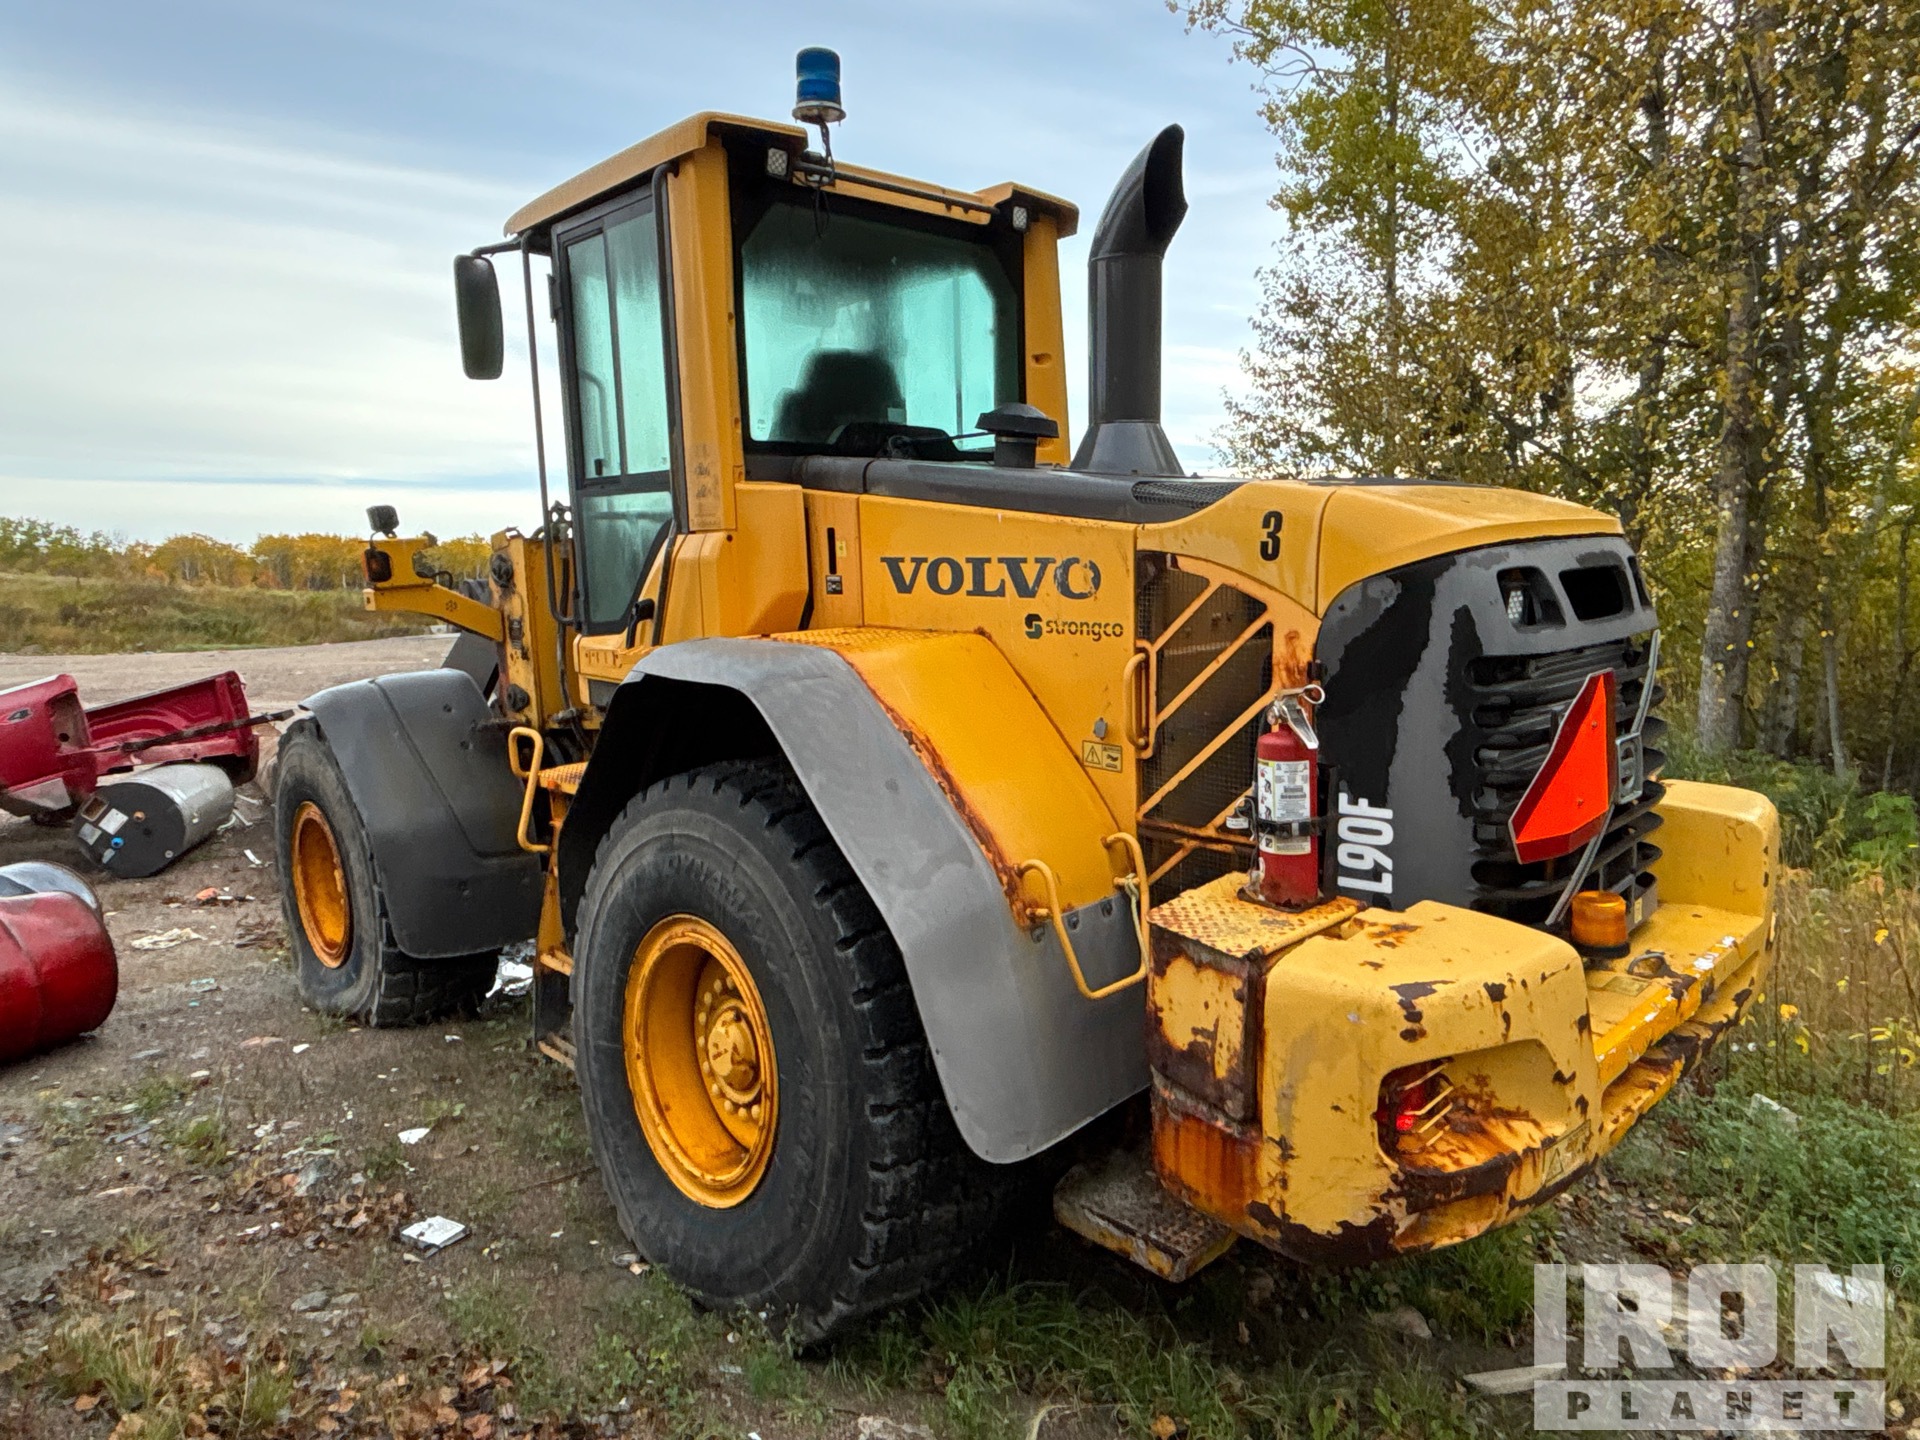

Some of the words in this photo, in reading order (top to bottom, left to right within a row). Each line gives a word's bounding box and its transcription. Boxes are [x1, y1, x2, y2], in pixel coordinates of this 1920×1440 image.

[1260, 510, 1283, 561] 3
[880, 556, 1102, 600] VOLVO
[1337, 792, 1394, 895] L90F
